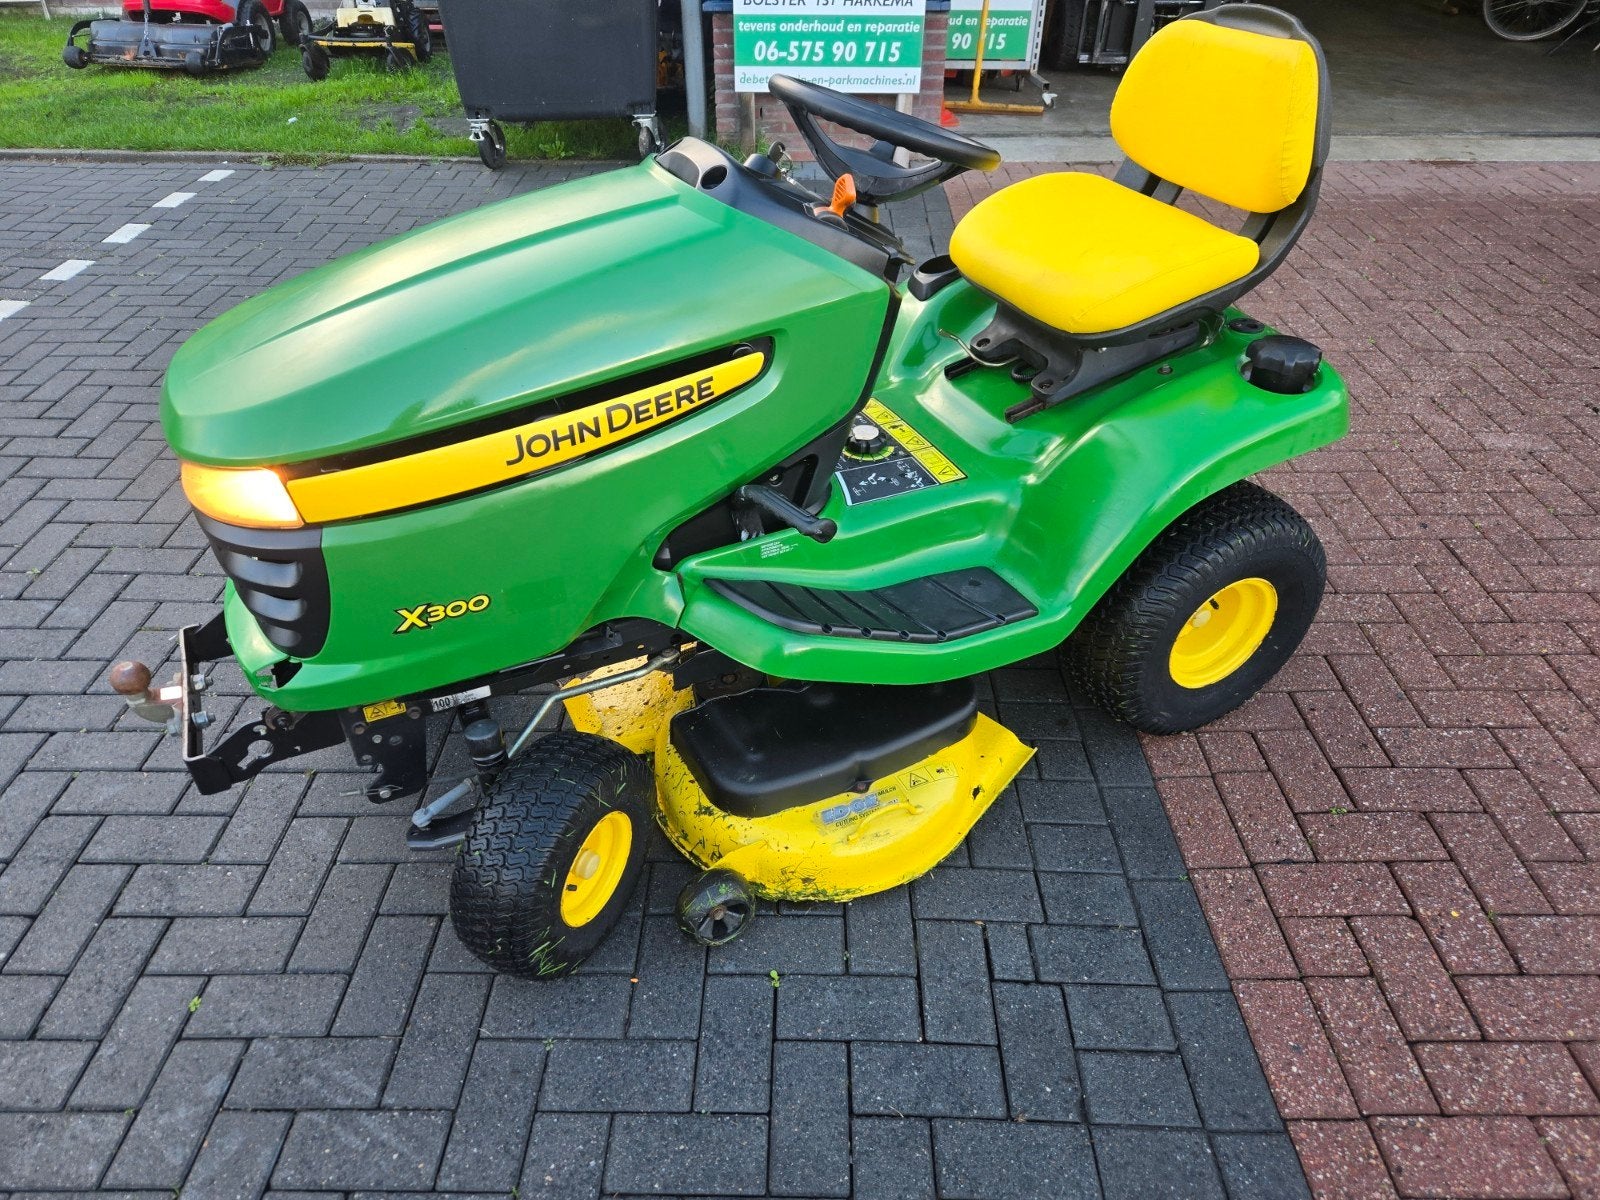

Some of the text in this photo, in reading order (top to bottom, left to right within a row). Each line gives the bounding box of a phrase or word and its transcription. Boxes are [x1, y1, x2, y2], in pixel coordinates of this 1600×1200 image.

[738, 19, 920, 36] tevens onderhoud en reparatie
[965, 16, 978, 26] en
[984, 15, 1028, 29] eparatie
[951, 32, 972, 50] 90
[754, 40, 901, 62] 06-575 90 715
[505, 375, 715, 468] JOHN DEERE
[391, 593, 492, 635] X300
[433, 696, 450, 710] 100
